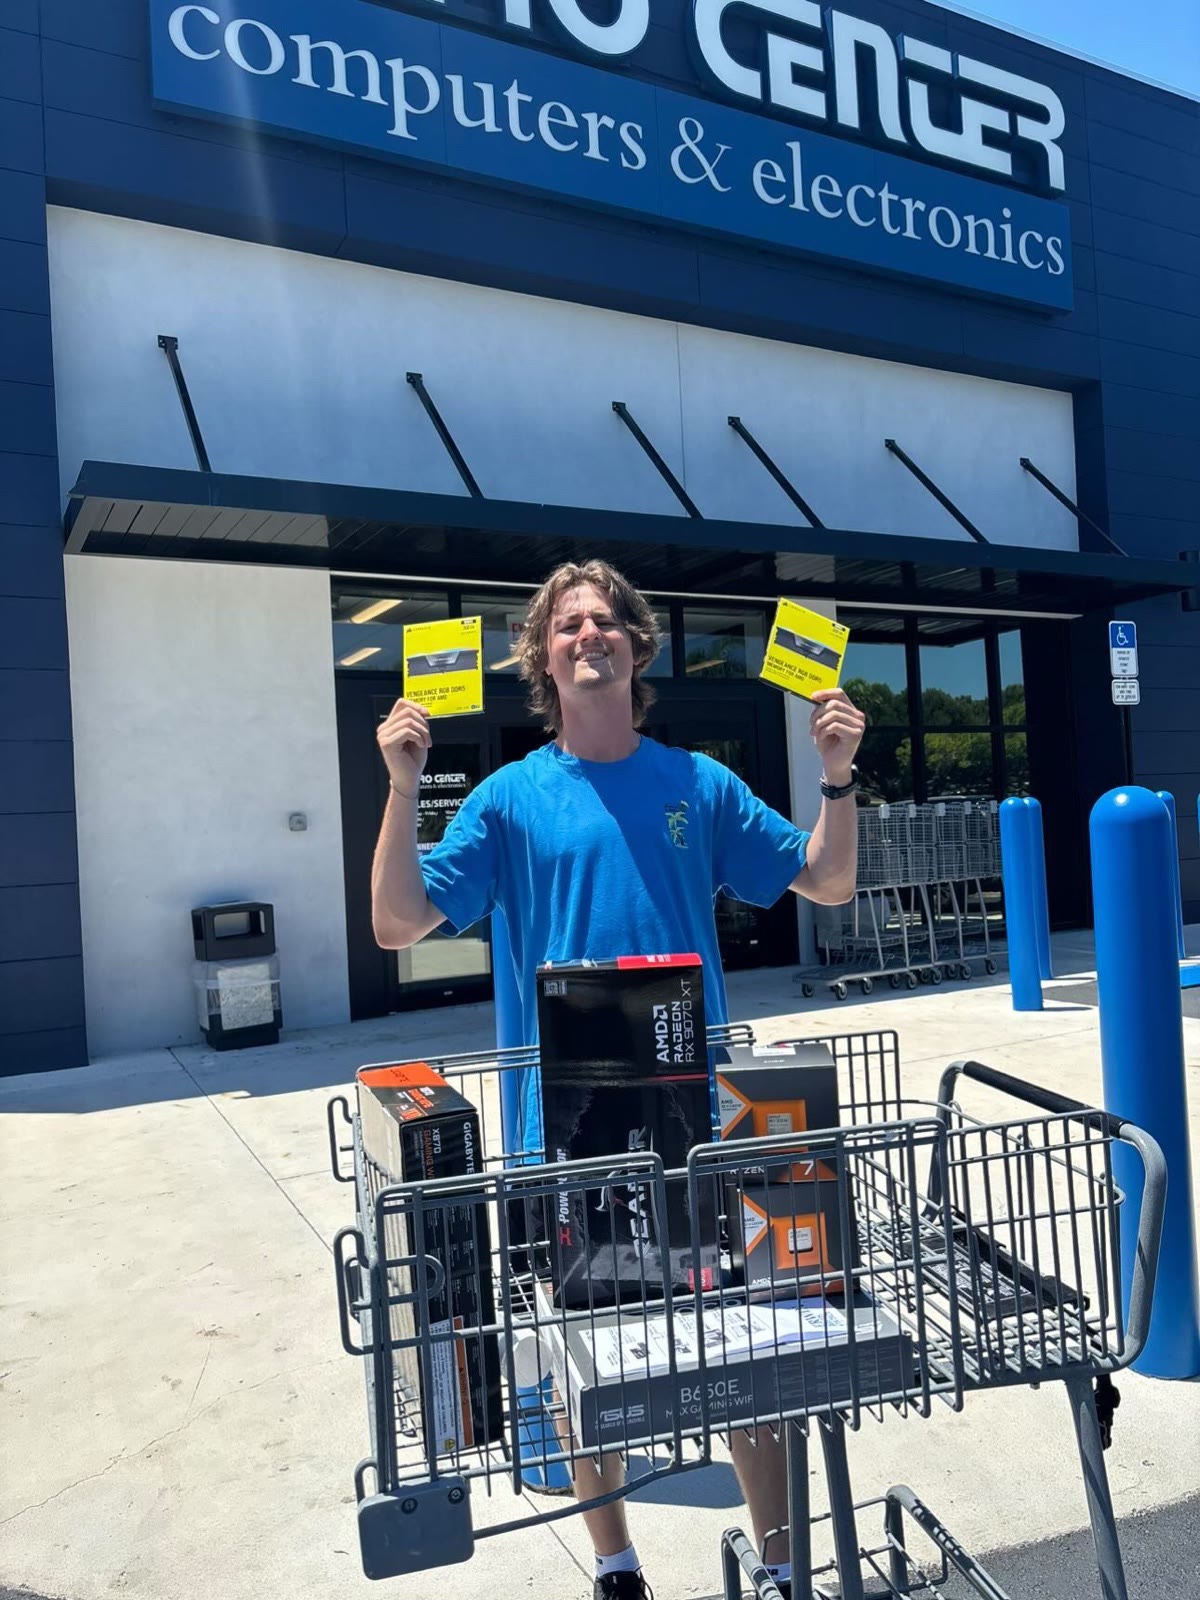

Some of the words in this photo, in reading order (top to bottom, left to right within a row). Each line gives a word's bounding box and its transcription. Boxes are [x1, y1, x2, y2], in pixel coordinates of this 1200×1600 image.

[694, 0, 1066, 191] CENTER
[167, 4, 648, 171] computers
[670, 116, 732, 193] &
[752, 141, 1066, 276] electronics
[434, 773, 466, 783] CENTER
[680, 978, 692, 997] XT
[671, 1001, 684, 1063] RADEON
[682, 1000, 694, 1040] 9070
[654, 1020, 670, 1063] AMD
[684, 1046, 695, 1063] RX
[432, 1127, 442, 1154] X870
[463, 1121, 475, 1175] GIGABYTE
[799, 1160, 814, 1176] 7
[734, 1393, 754, 1406] WIF
